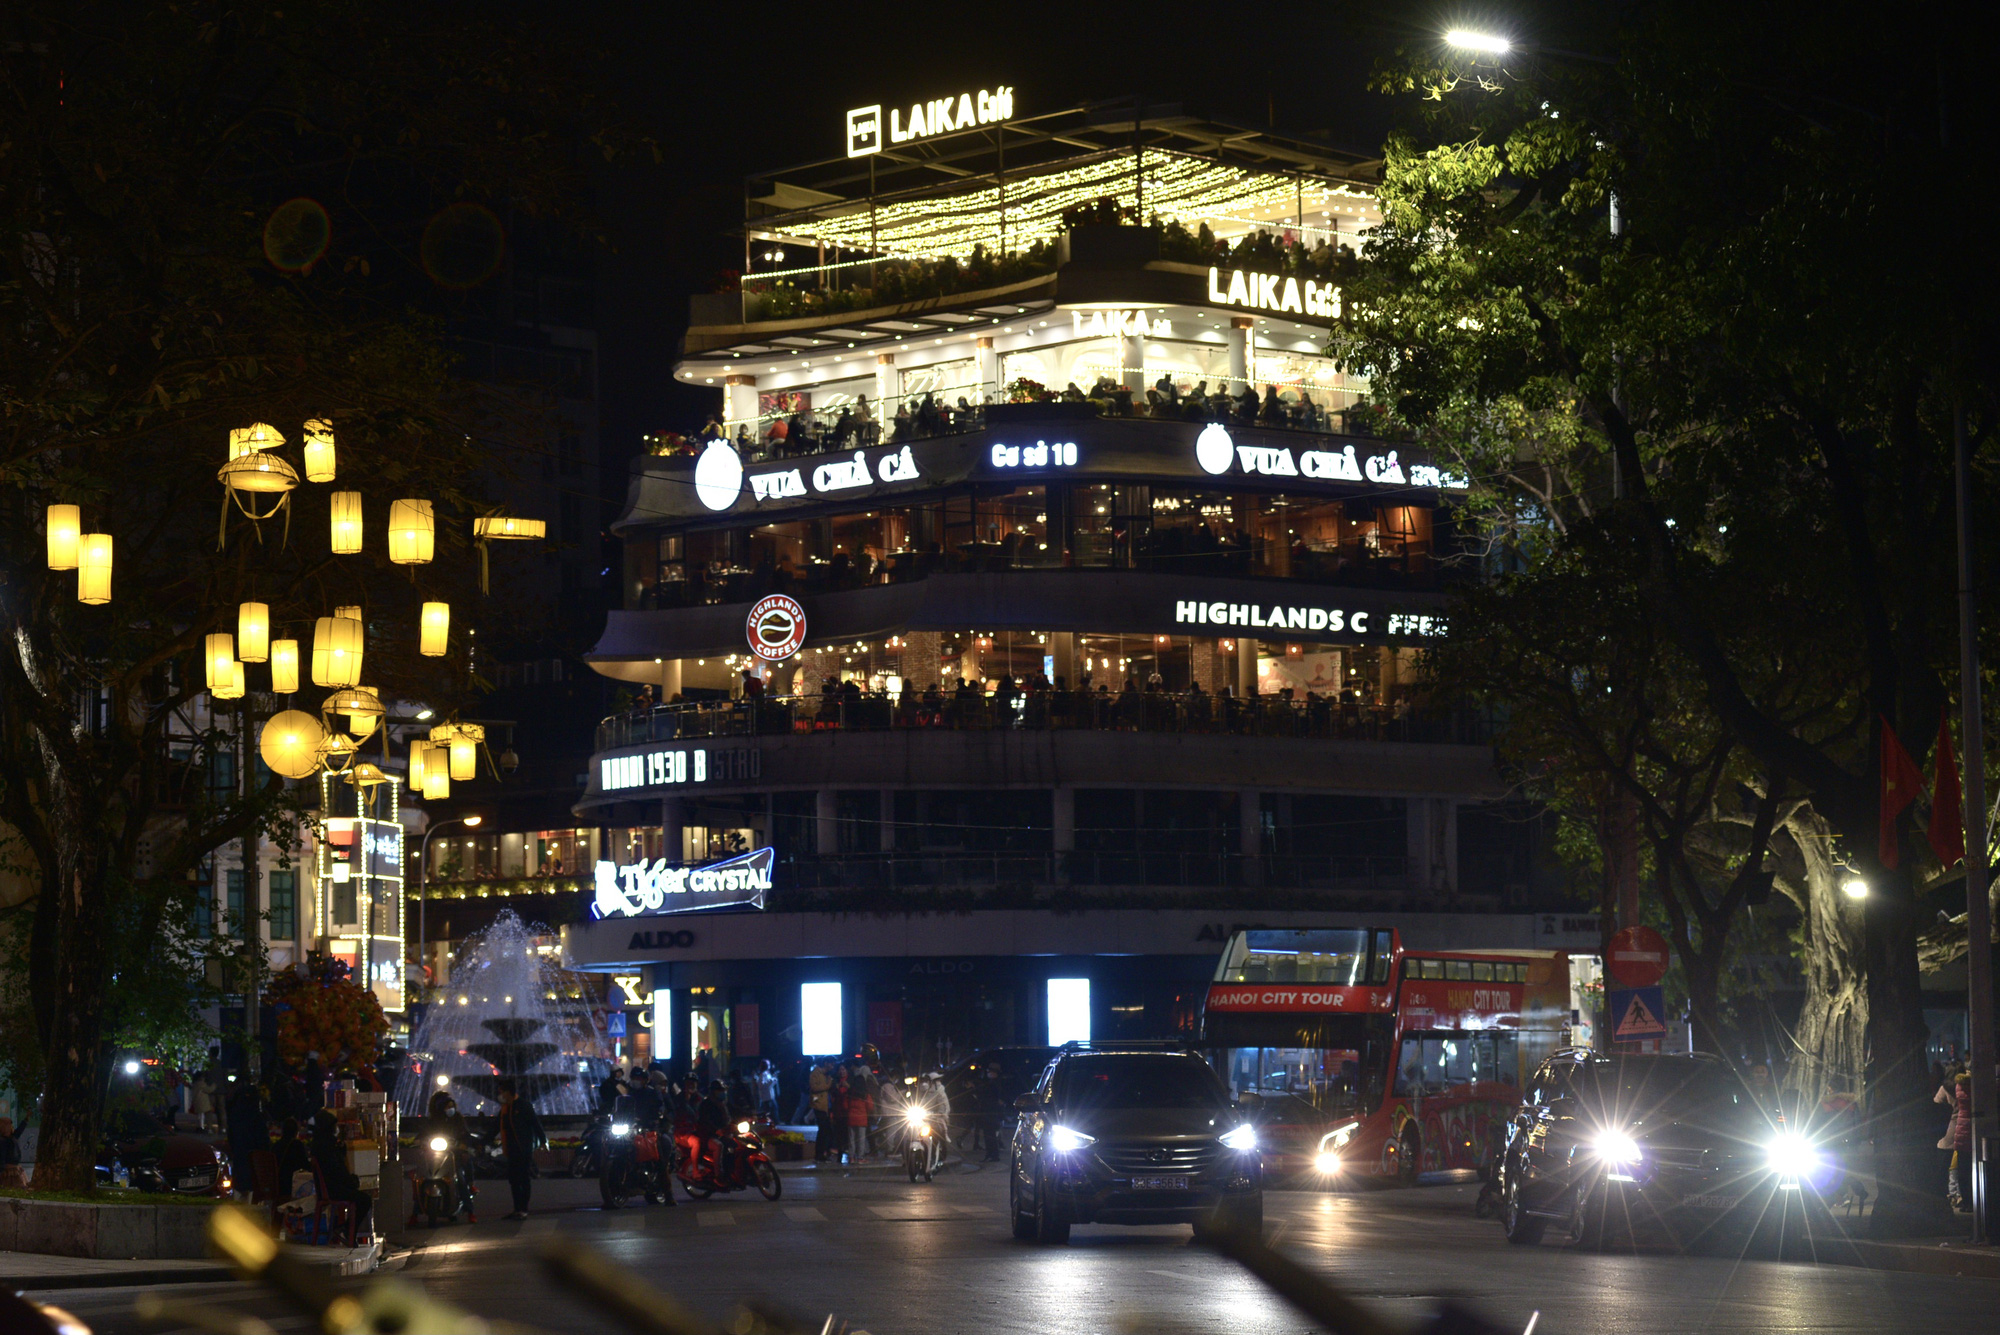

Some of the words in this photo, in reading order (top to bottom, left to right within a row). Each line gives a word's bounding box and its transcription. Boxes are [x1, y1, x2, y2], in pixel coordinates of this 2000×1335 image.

[891, 97, 976, 143] LAIKA
[1208, 267, 1303, 314] LAIKA
[1071, 310, 1151, 337] LAIKA
[1052, 442, 1078, 466] 10
[1236, 446, 1298, 477] VUA
[749, 469, 807, 501] VUA
[749, 598, 803, 628] HIGHLANDS
[1176, 600, 1345, 632] HIGHLANDS
[756, 638, 798, 657] COFFEE
[647, 750, 686, 785] 1930
[689, 868, 772, 892] CRYSTAL
[629, 930, 695, 950] ALDO
[909, 961, 974, 974] ALDO
[1210, 992, 1258, 1007] HANOI
[1261, 993, 1298, 1005] CITY
[1301, 992, 1344, 1006] TOUR
[1473, 989, 1490, 1010] CITY
[1491, 990, 1511, 1010] TOUR
